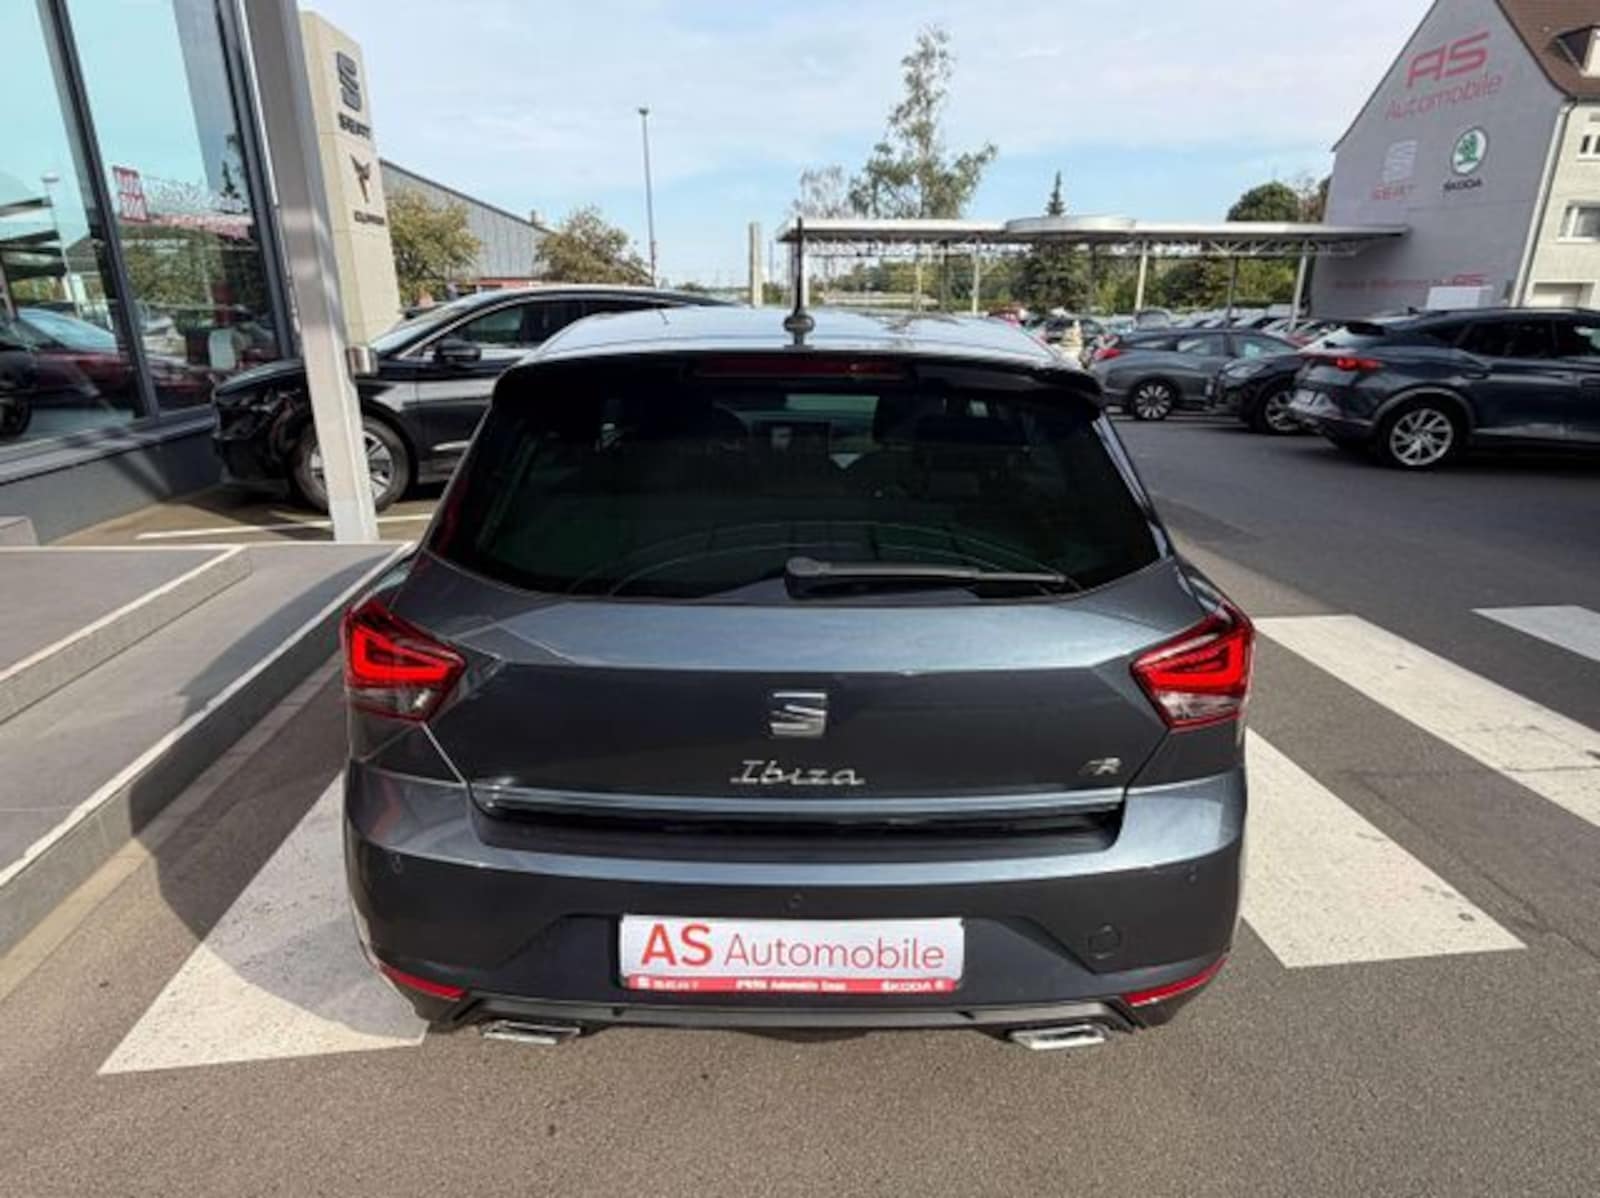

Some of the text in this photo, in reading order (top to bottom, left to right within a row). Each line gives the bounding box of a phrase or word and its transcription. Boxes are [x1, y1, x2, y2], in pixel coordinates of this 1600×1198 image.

[1406, 31, 1490, 88] AS
[1385, 74, 1503, 120] Automobile
[729, 759, 865, 785] Ibiza
[641, 923, 945, 970] AS Automobile
